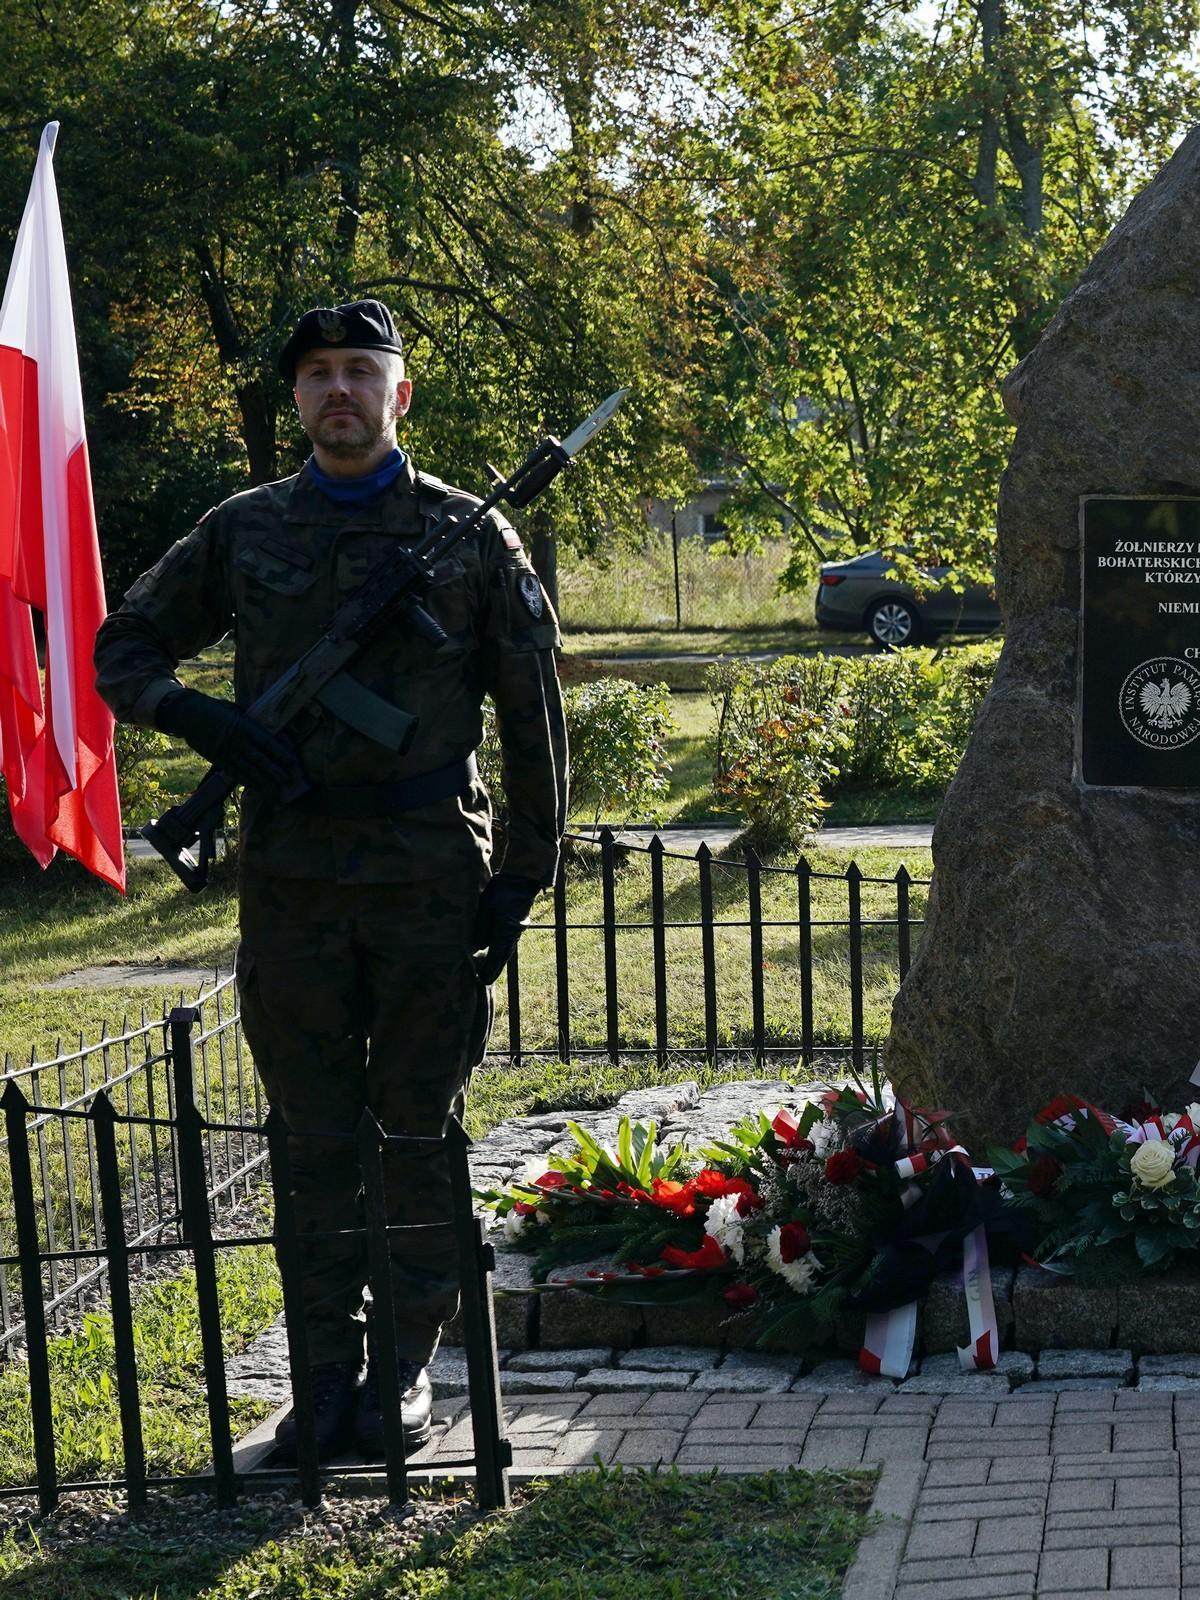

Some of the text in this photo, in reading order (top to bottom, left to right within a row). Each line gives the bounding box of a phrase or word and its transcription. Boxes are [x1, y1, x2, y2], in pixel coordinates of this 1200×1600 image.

[1115, 539, 1194, 552] ŻOŁNIERZY
[1125, 663, 1167, 711] INSTYTUT
[1129, 716, 1200, 744] NARODOWEJ
